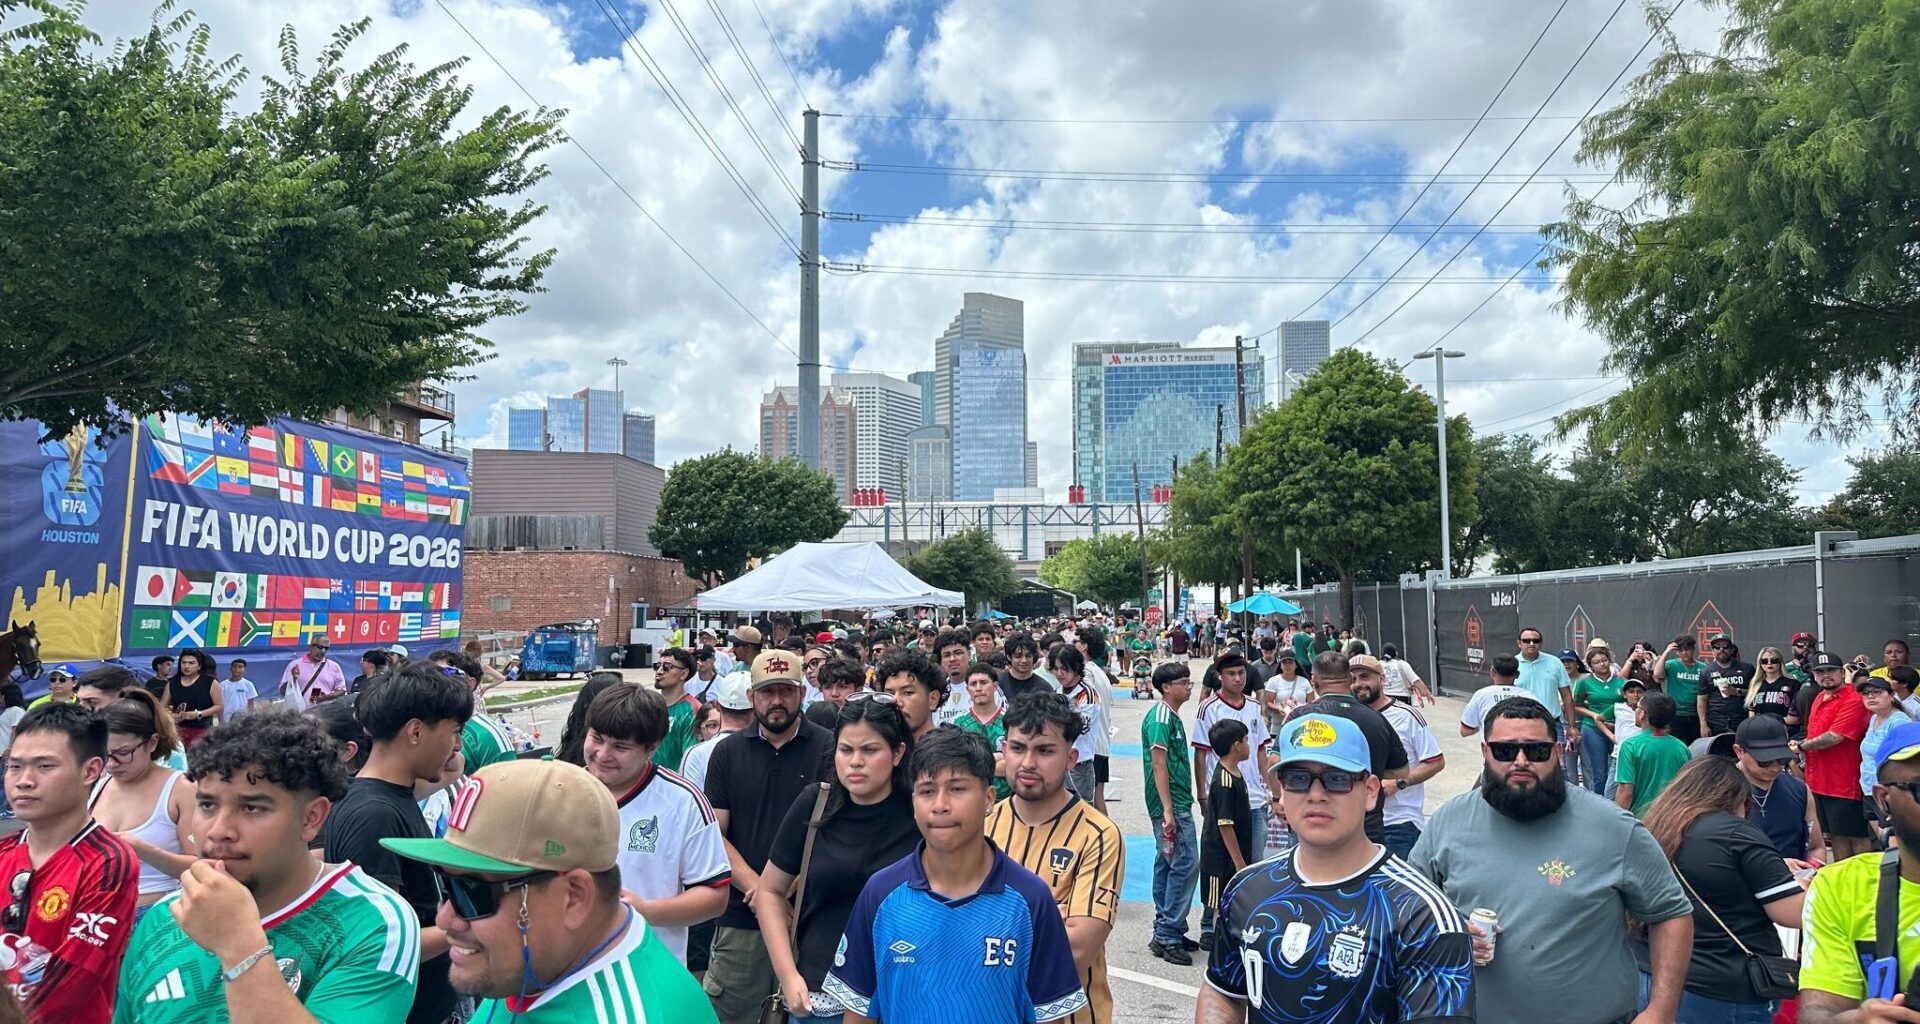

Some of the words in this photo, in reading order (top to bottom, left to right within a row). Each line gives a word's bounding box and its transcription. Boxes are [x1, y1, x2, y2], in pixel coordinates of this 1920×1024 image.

[1124, 354, 1183, 364] MARRIOTT
[61, 499, 88, 514] FIFA
[41, 529, 100, 544] HOUSTON
[141, 499, 222, 551] FIFA
[229, 512, 330, 560] WORLD
[334, 526, 385, 564] CUP
[389, 533, 461, 569] 2026
[1146, 611, 1163, 620] STOP
[1676, 672, 1700, 681] MÉXIC
[1713, 676, 1744, 687] MXICO
[1308, 720, 1329, 729] Bass
[1307, 728, 1324, 736] Pro
[1308, 735, 1333, 744] Shops
[70, 912, 117, 940] DXC
[983, 936, 1018, 967] ES
